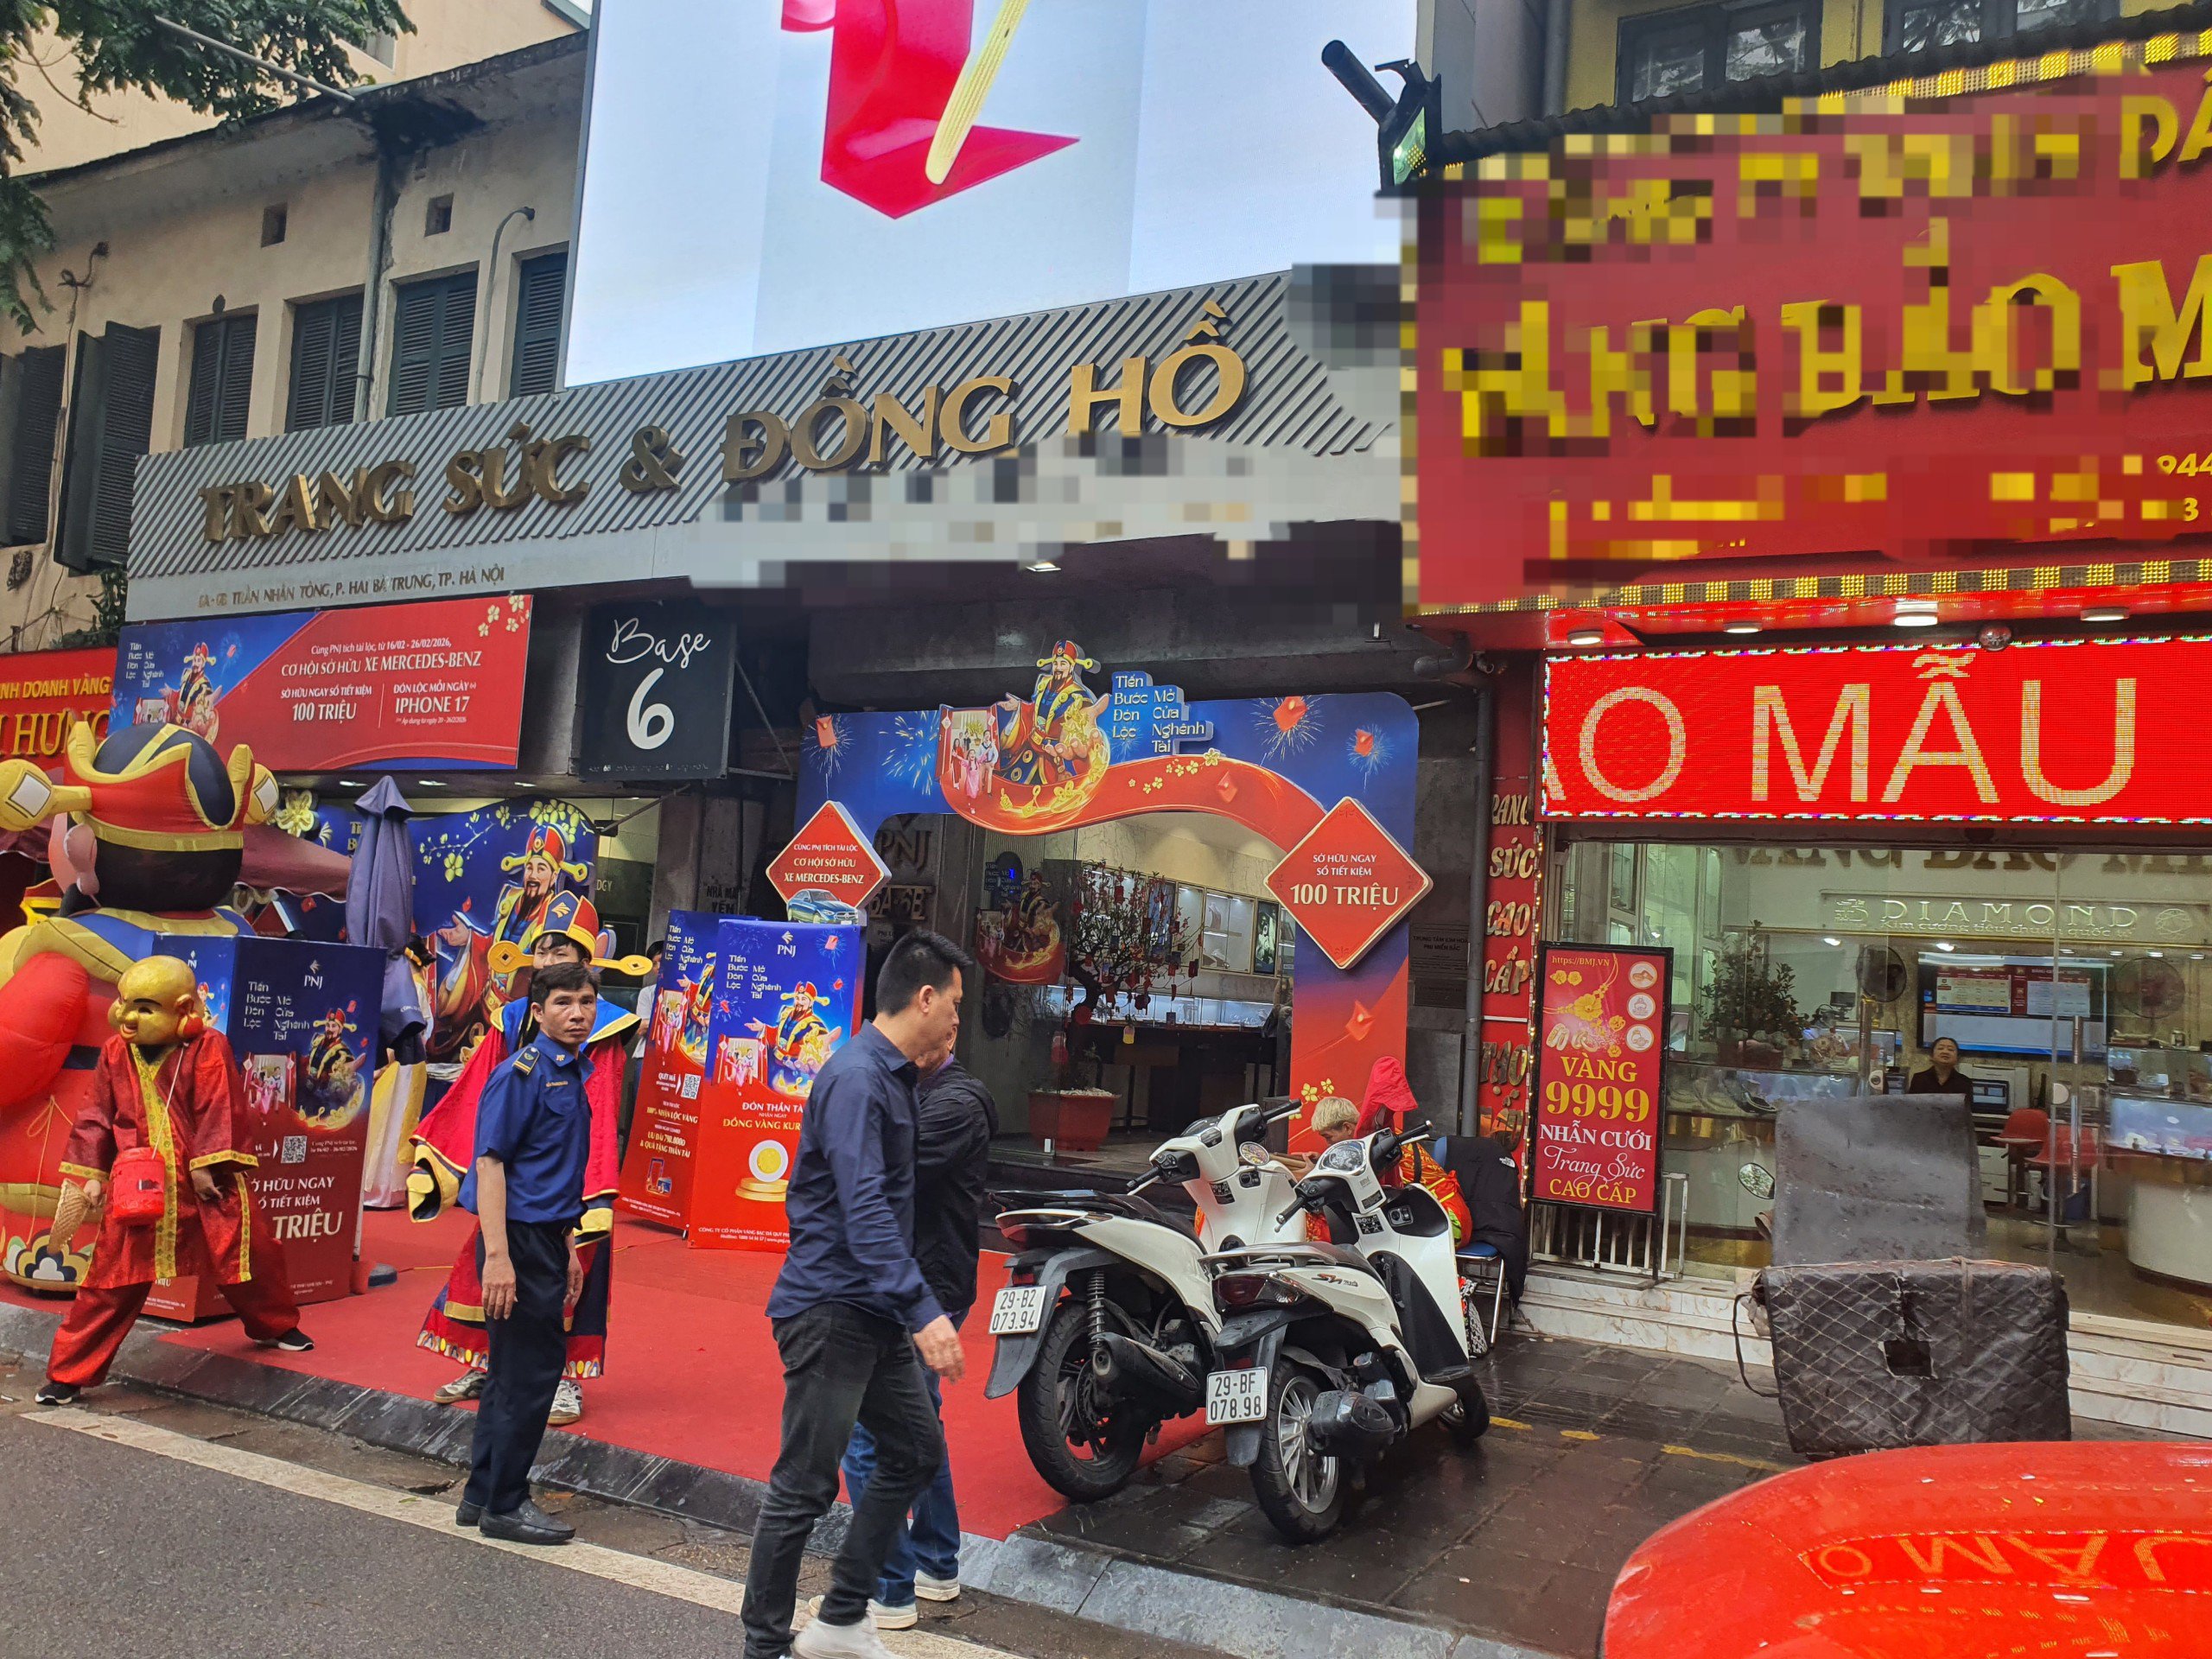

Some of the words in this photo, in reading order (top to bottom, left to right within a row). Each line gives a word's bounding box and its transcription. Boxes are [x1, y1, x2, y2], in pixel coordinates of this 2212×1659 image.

[198, 460, 416, 543] TRANG
[442, 421, 592, 515] SỨC
[618, 424, 688, 494] &
[720, 355, 1020, 484] ĐỒNG
[1067, 300, 1249, 435] HỒ
[349, 581, 369, 594] HAI
[459, 568, 477, 585] HÀ
[480, 566, 505, 585] NỘI
[329, 643, 342, 655] PNJ
[387, 639, 405, 650] 16/02
[410, 637, 452, 649] 26/02/2026,
[607, 618, 711, 669] Base
[281, 661, 298, 677] CƠ
[299, 661, 319, 678] HỘI
[321, 659, 336, 675] SỞ
[337, 658, 362, 674] HỮU
[364, 657, 379, 672] XE
[380, 651, 482, 671] MERCEDES-BENZ
[22, 680, 69, 698] DOANH
[73, 672, 112, 696] VÀNG
[308, 686, 329, 697] NGAY
[412, 682, 429, 695] LỘC
[447, 679, 469, 692] NGÀY
[1116, 674, 1144, 689] Tiến
[395, 696, 452, 714] IPHONE
[454, 696, 471, 713] 17
[1154, 689, 1176, 702] Mở
[292, 702, 315, 721] 100
[318, 698, 357, 724] TRIỆU
[627, 668, 674, 749] 6
[1153, 705, 1179, 719] Cửa
[1112, 726, 1137, 740] Lộc
[1152, 721, 1205, 739] Nghênh
[1546, 686, 1686, 802] O
[1751, 652, 2136, 806] MẪU
[1152, 740, 1171, 753] Tài
[794, 857, 805, 866] CƠ
[807, 856, 823, 869] HỘI
[825, 855, 836, 867] SỞ
[837, 857, 856, 868] HỮU
[1313, 854, 1325, 863] SỞ
[1327, 854, 1348, 863] HỮU
[1351, 854, 1376, 863] NGAY
[1489, 836, 1535, 879] SỨC
[785, 873, 795, 882] XE
[795, 873, 864, 884] MERCEDES-BENZ
[1316, 865, 1329, 875] SỔ
[1331, 865, 1348, 875] TIẾT
[1350, 866, 1372, 877] KIỆM
[1289, 883, 1328, 905] 100
[1333, 881, 1399, 911] TRIỆU
[1486, 899, 1530, 936] CAO
[1882, 900, 2139, 928] DIAMOND
[777, 944, 796, 957] PNJ
[1551, 955, 1610, 968] https://BMJ.VN
[1484, 945, 1530, 995] CẤP
[304, 975, 323, 990] PNJ
[1560, 1052, 1637, 1083] VÀNG
[742, 1102, 764, 1111] ĐÓN
[766, 1102, 791, 1113] THẦN
[1546, 1081, 1649, 1122] 9999
[722, 1116, 753, 1128] ĐỒNG
[754, 1119, 780, 1129] VÀNG
[1540, 1121, 1597, 1145] NHẪN
[1601, 1127, 1652, 1150] CƯỚI
[1543, 1145, 1601, 1187] Trang
[1604, 1153, 1645, 1181] Sức
[263, 1178, 295, 1192] HỮU
[298, 1176, 335, 1190] NGAY
[1549, 1179, 1590, 1198] CAO
[1597, 1180, 1637, 1204] CẤP
[270, 1194, 291, 1209] TIẾT
[295, 1194, 321, 1209] KIỆM
[272, 1207, 343, 1243] TRIỆU
[1000, 1288, 1037, 1310] 29-B2
[992, 1310, 1035, 1332] 073.94
[1215, 1372, 1255, 1397] 29-BF
[1211, 1395, 1262, 1421] 078.98
